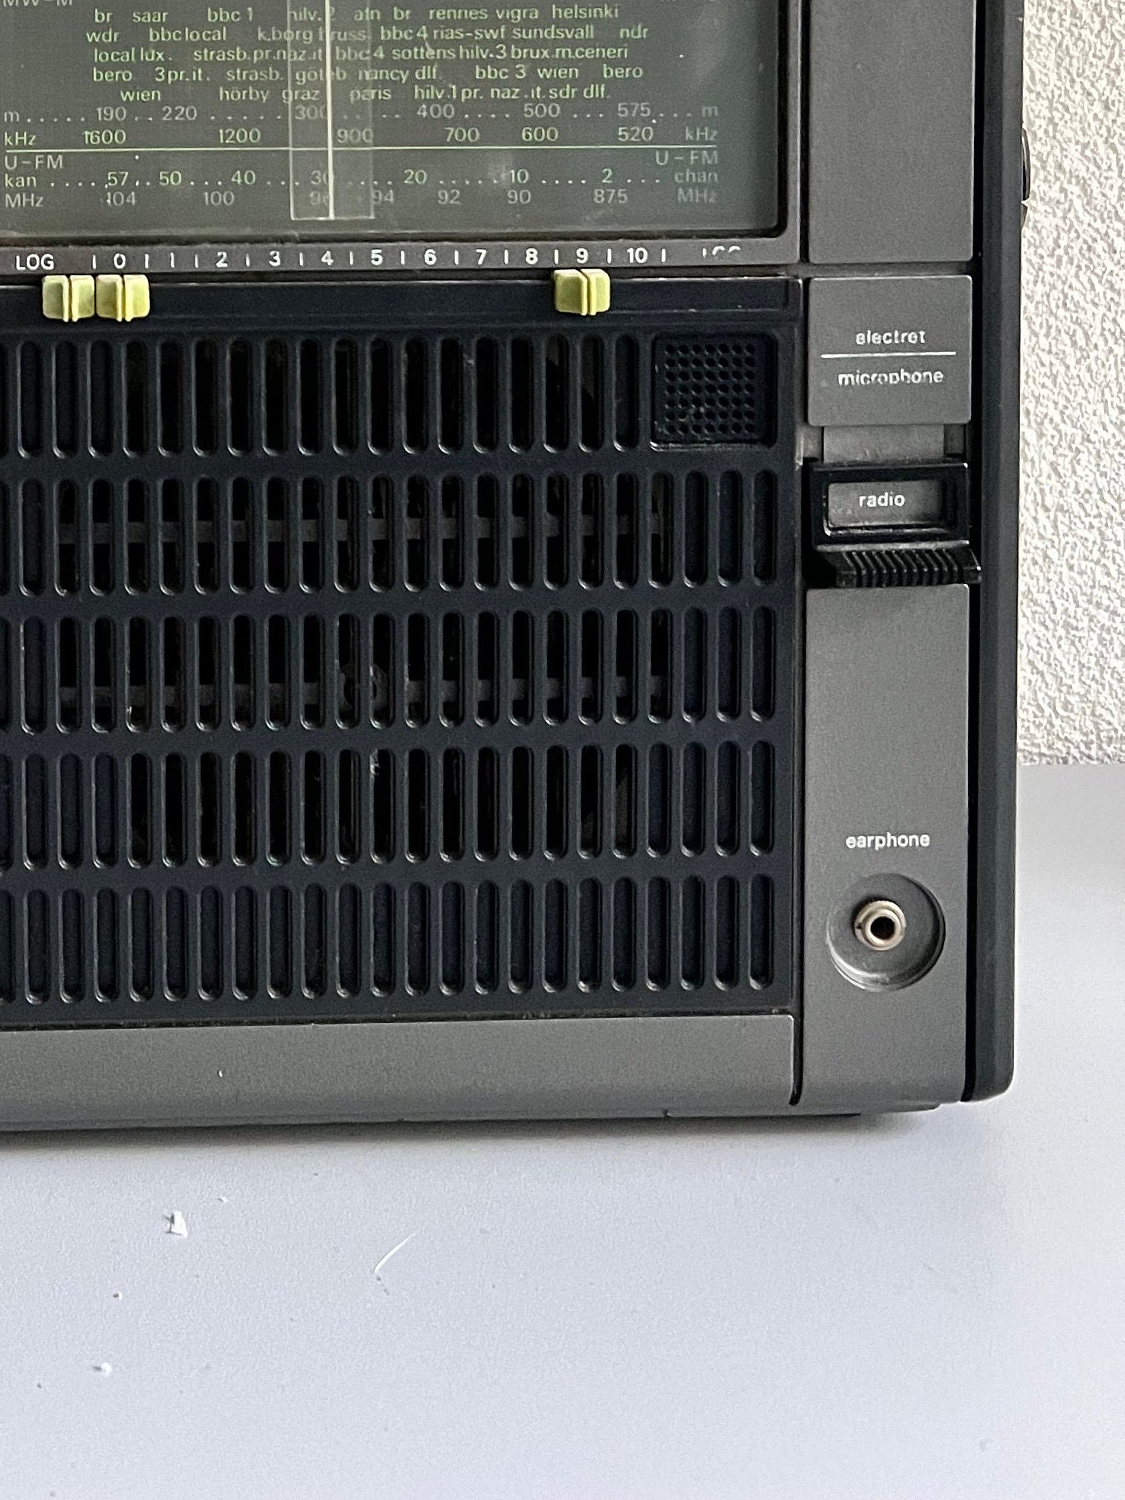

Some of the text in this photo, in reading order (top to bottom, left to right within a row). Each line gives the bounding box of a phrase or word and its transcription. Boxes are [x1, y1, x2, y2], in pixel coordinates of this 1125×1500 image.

[95, 8, 112, 23] br
[132, 11, 168, 23] saar
[207, 7, 241, 22] bbc
[394, 6, 411, 20] br
[429, 8, 488, 20] rennes
[495, 6, 539, 23] vigra
[552, 4, 619, 19] helsinki
[86, 27, 119, 42] wdr
[380, 25, 413, 40] bbc
[416, 25, 428, 39] 4
[433, 24, 505, 39] rias-swf
[512, 24, 594, 39] sundsvall
[620, 23, 649, 39] ndr
[335, 46, 370, 60] bbc
[373, 45, 385, 59] 4
[392, 46, 455, 60] sottens
[93, 66, 132, 81] bero
[296, 66, 347, 85] götb
[359, 69, 409, 83] nancy
[475, 65, 509, 79] bbc
[515, 64, 526, 79] 3
[537, 64, 579, 79] wien
[603, 63, 643, 78] bero
[120, 86, 161, 102] wien
[282, 89, 320, 104] graz
[350, 85, 392, 104] paris
[549, 84, 577, 99] sdr
[4, 111, 20, 122] m
[96, 106, 126, 121] 190
[162, 106, 197, 121] 220
[417, 103, 455, 118] 400
[524, 103, 560, 118] 500
[618, 102, 651, 117] 575
[702, 105, 718, 117] m
[4, 127, 717, 146] kHz 1600 1200 900 700 600 520 kHz
[5, 173, 36, 187] kan
[107, 171, 128, 186] 57
[159, 171, 181, 186] 50
[231, 170, 256, 185] 40
[404, 169, 427, 184] 20
[509, 169, 529, 183] 10
[602, 168, 613, 183] 2
[675, 168, 718, 183] chan
[5, 193, 43, 208] MHz
[106, 191, 136, 206] 104
[203, 190, 235, 206] 100
[438, 189, 460, 204] 92
[507, 189, 531, 204] 90
[677, 187, 716, 203] MHz
[15, 254, 55, 271] LOG
[113, 253, 126, 269] 0
[215, 252, 228, 267] 2
[268, 251, 282, 267] 3
[321, 251, 334, 267] 4
[371, 250, 383, 266] 5
[424, 249, 437, 265] 6
[475, 249, 487, 265] 7
[525, 249, 538, 265] 8
[576, 248, 588, 264] 9
[627, 247, 648, 264] 10
[856, 330, 925, 345] electret
[838, 368, 944, 386] microphone
[859, 492, 905, 507] radio
[846, 832, 930, 851] earphone
